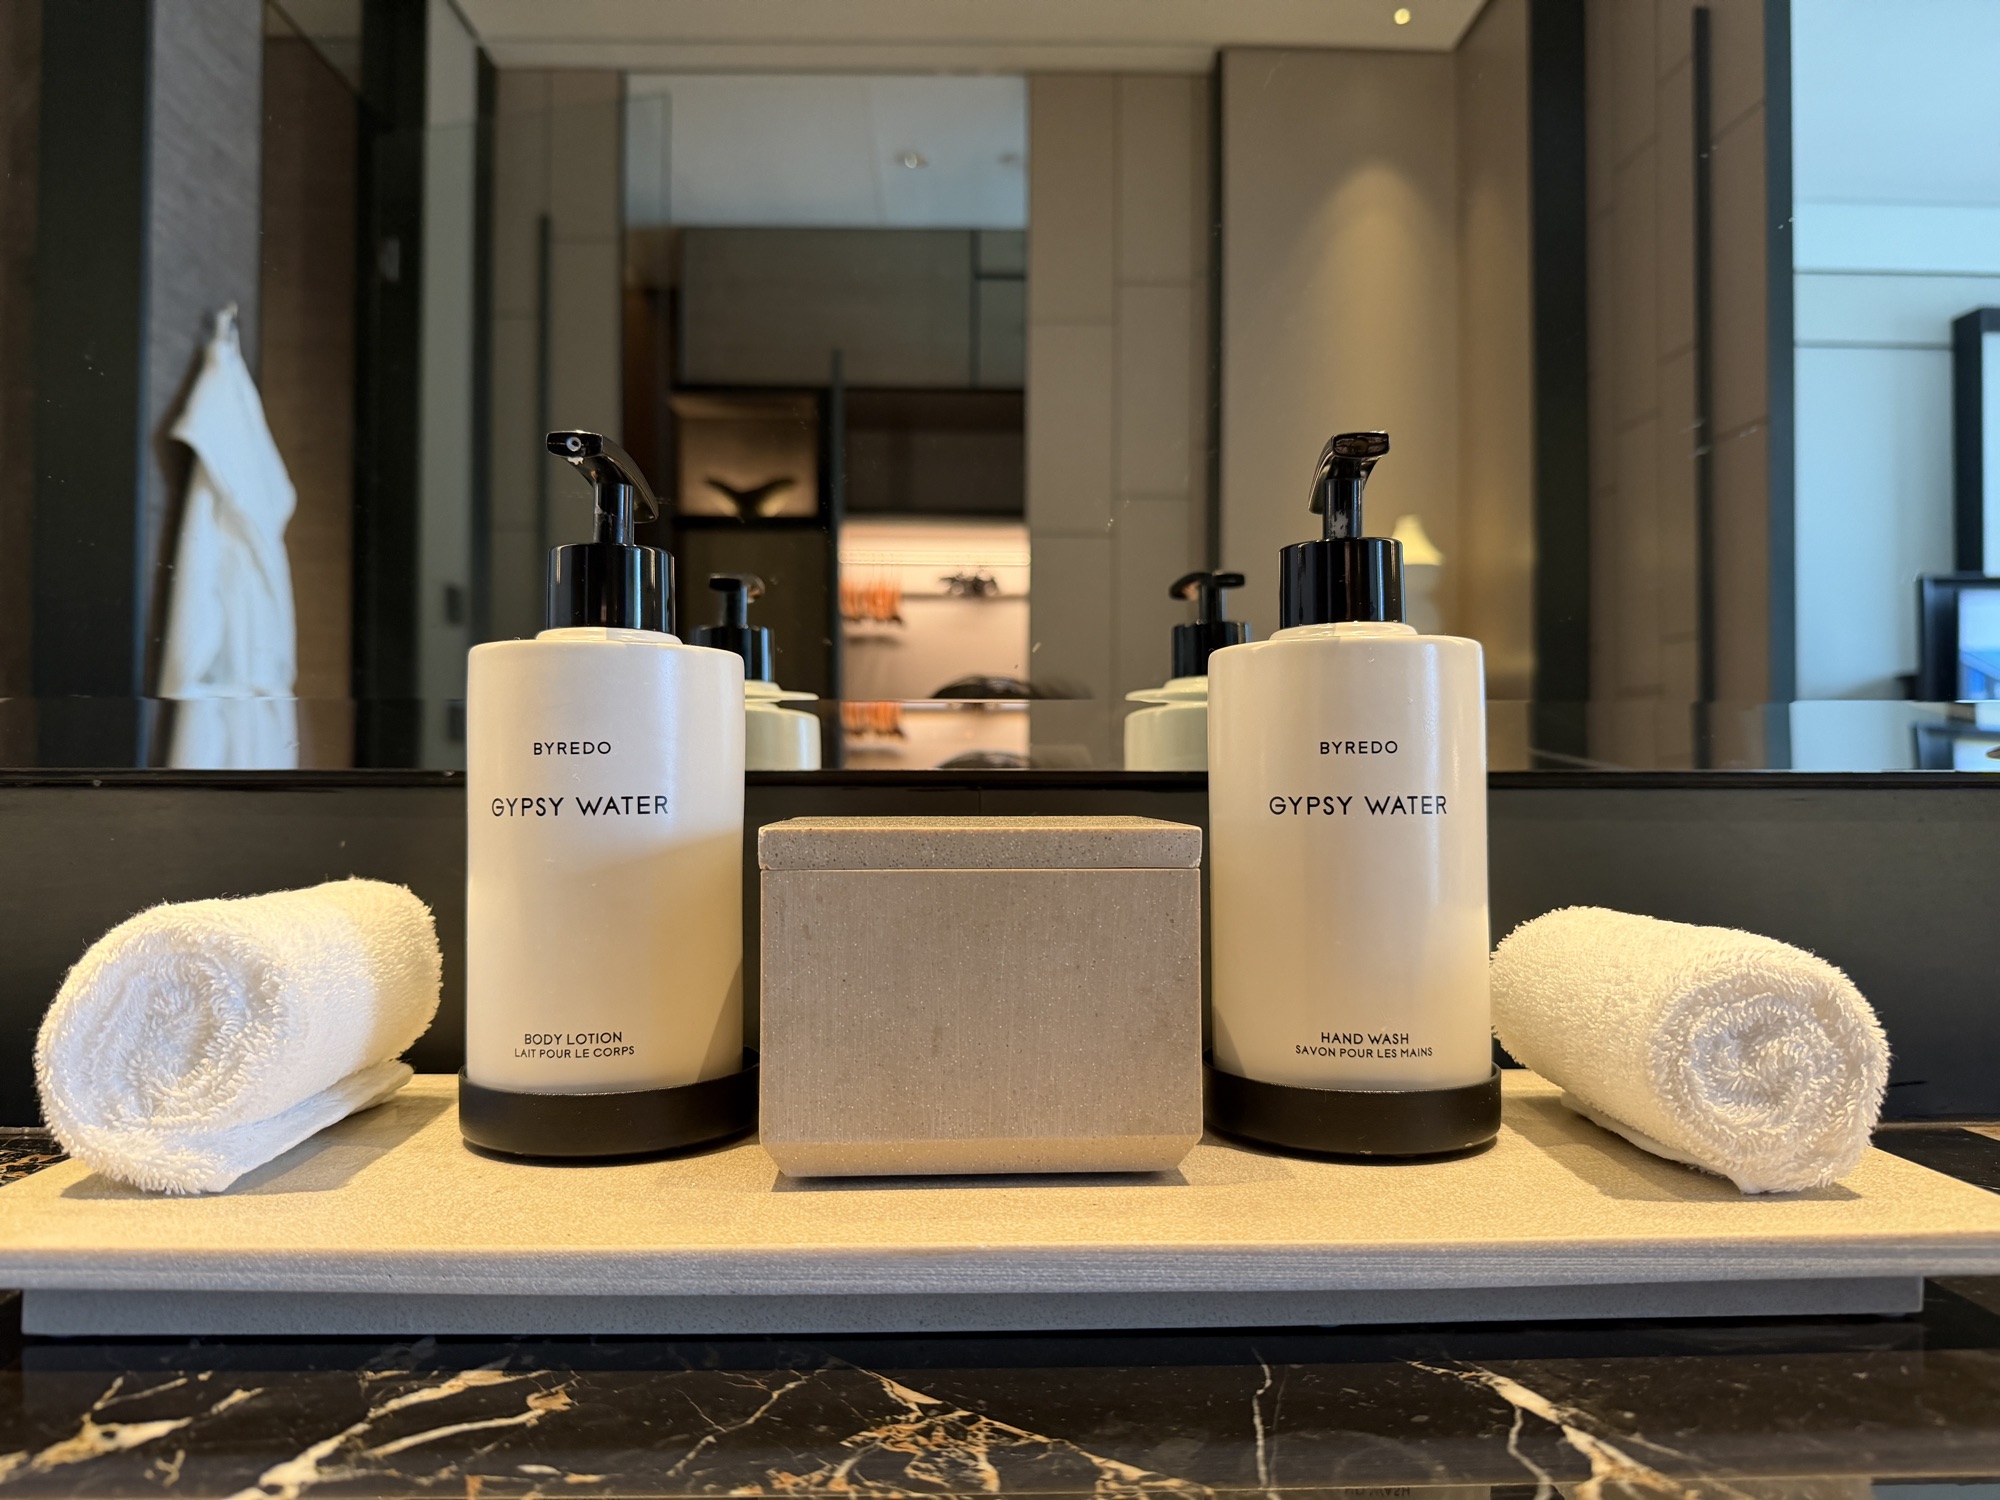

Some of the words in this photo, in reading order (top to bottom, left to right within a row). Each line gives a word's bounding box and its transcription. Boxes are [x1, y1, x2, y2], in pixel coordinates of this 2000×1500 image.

[533, 741, 612, 756] BYREDO
[1319, 740, 1399, 755] BYREDO
[491, 796, 565, 818] GYPSY
[576, 795, 670, 816] WATER
[1268, 795, 1353, 816] GYPSY
[1364, 794, 1448, 815] WATER
[524, 1033, 563, 1046] BODY
[566, 1031, 623, 1045] LOTION
[1320, 1031, 1364, 1045] HAND
[1367, 1032, 1409, 1045] WASH
[514, 1047, 536, 1059] LAIT
[539, 1048, 572, 1059] POUR
[575, 1048, 590, 1059] LE
[593, 1045, 635, 1058] CORPS
[1295, 1044, 1336, 1057] SAVON
[1339, 1047, 1374, 1059] POUR
[1377, 1048, 1398, 1059] LES
[1400, 1046, 1433, 1058] MAINS
